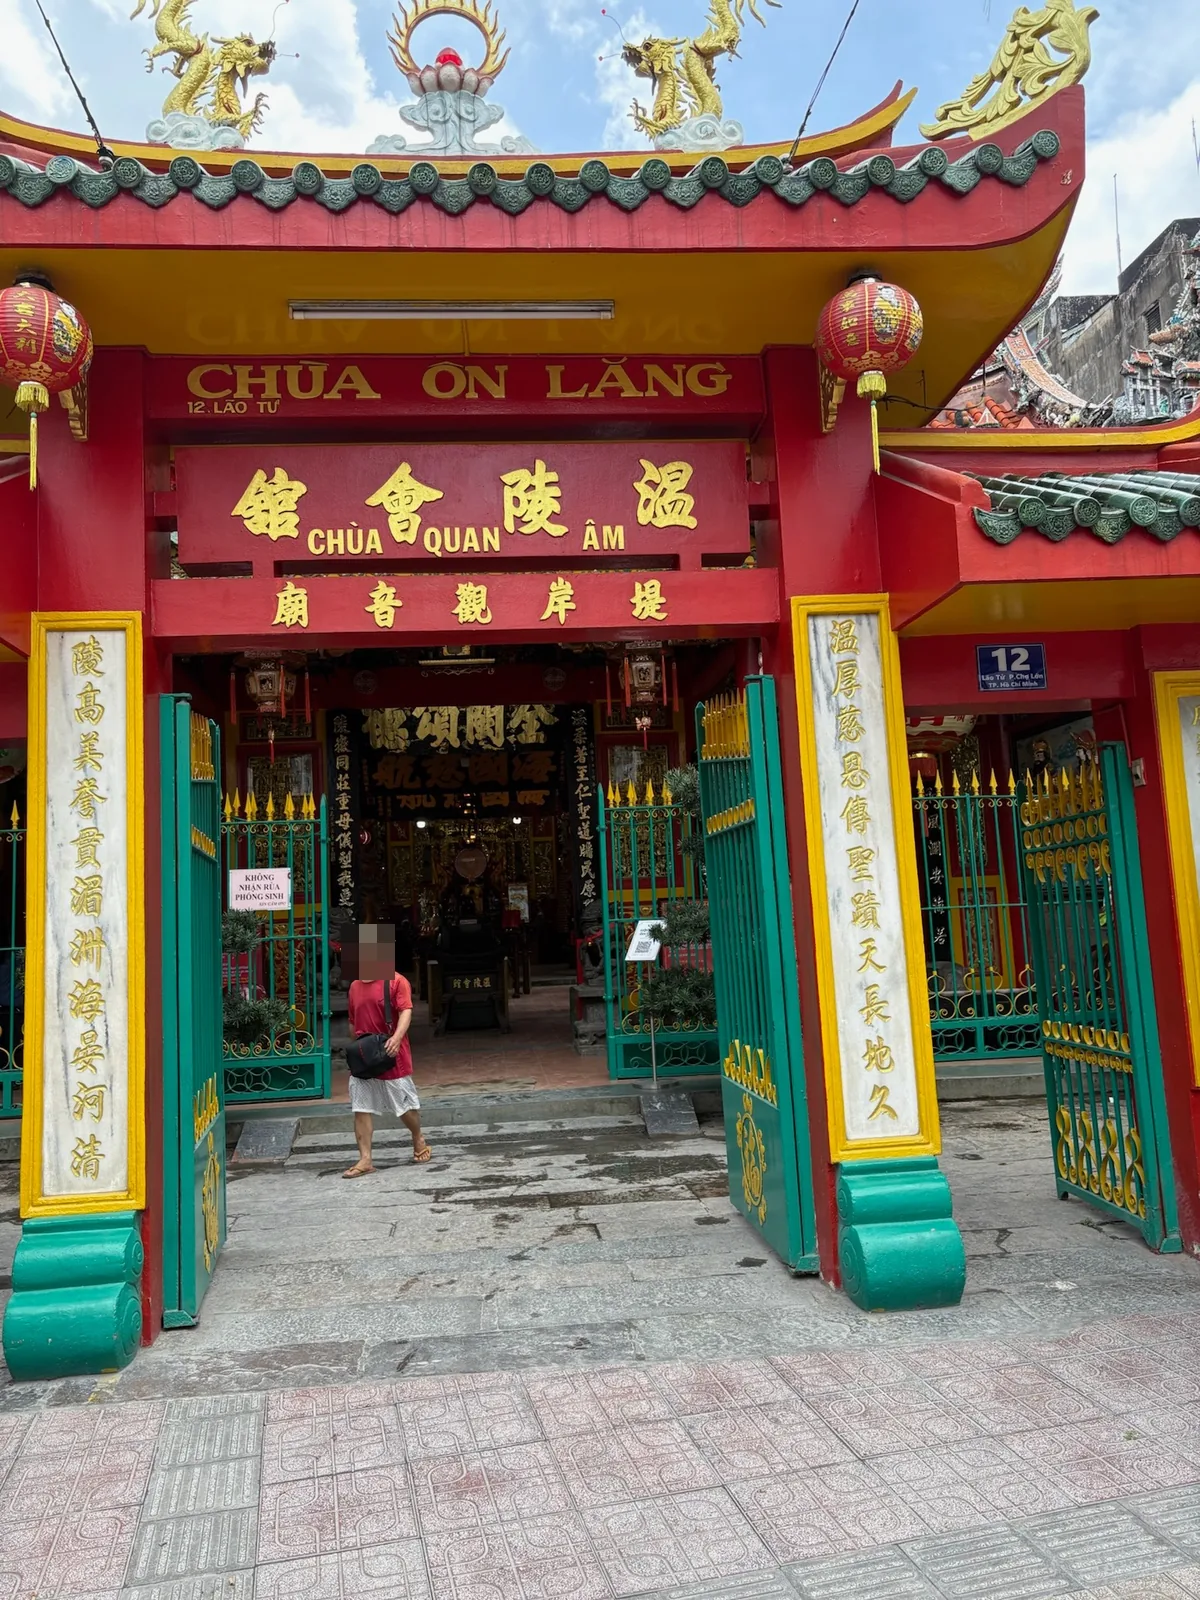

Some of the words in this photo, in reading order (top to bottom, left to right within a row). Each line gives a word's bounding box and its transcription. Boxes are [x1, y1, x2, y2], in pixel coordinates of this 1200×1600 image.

[187, 360, 381, 399] CHÙA
[421, 361, 508, 399] ÔN
[545, 356, 733, 398] LĂNG
[213, 399, 248, 414] LÃO
[306, 521, 384, 556] CHÙA
[423, 526, 501, 557] QUAN
[582, 518, 626, 552] ÂM
[991, 647, 1031, 672] 12
[245, 872, 275, 882] KHÔNG
[239, 884, 261, 892] NHẬN
[235, 892, 263, 901] PHÓNG
[265, 892, 284, 900] SINH
